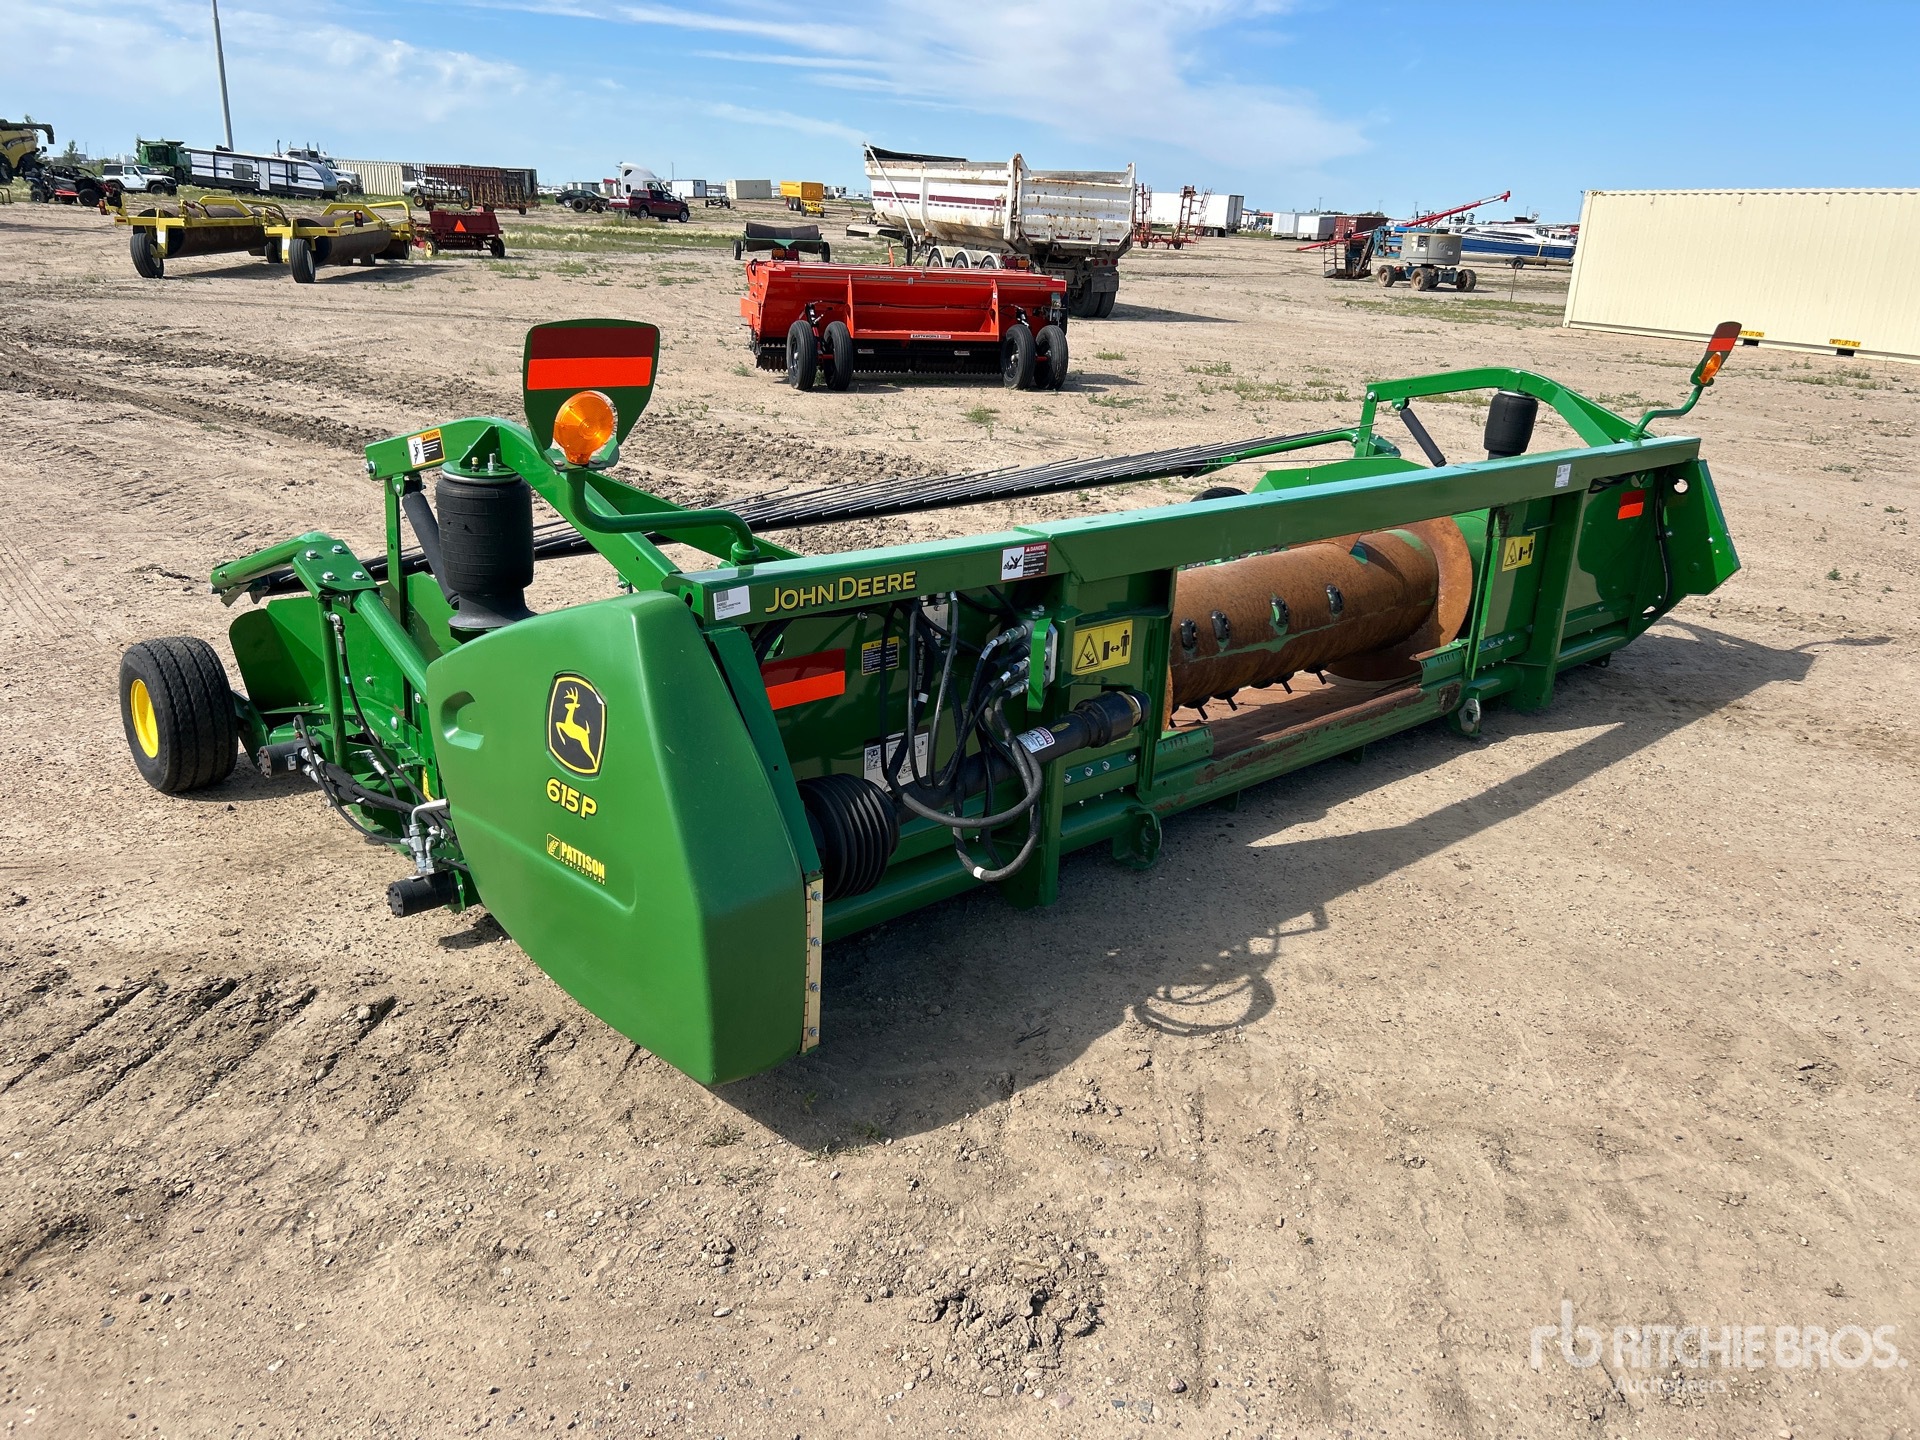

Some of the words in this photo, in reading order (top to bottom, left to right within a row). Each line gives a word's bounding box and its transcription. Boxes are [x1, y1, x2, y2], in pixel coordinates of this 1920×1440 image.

[765, 583, 834, 613] JOHN
[838, 571, 916, 601] DEERE
[546, 777, 598, 819] 615P
[561, 841, 605, 879] PATTISON
[561, 857, 606, 885] AGRICULTURE
